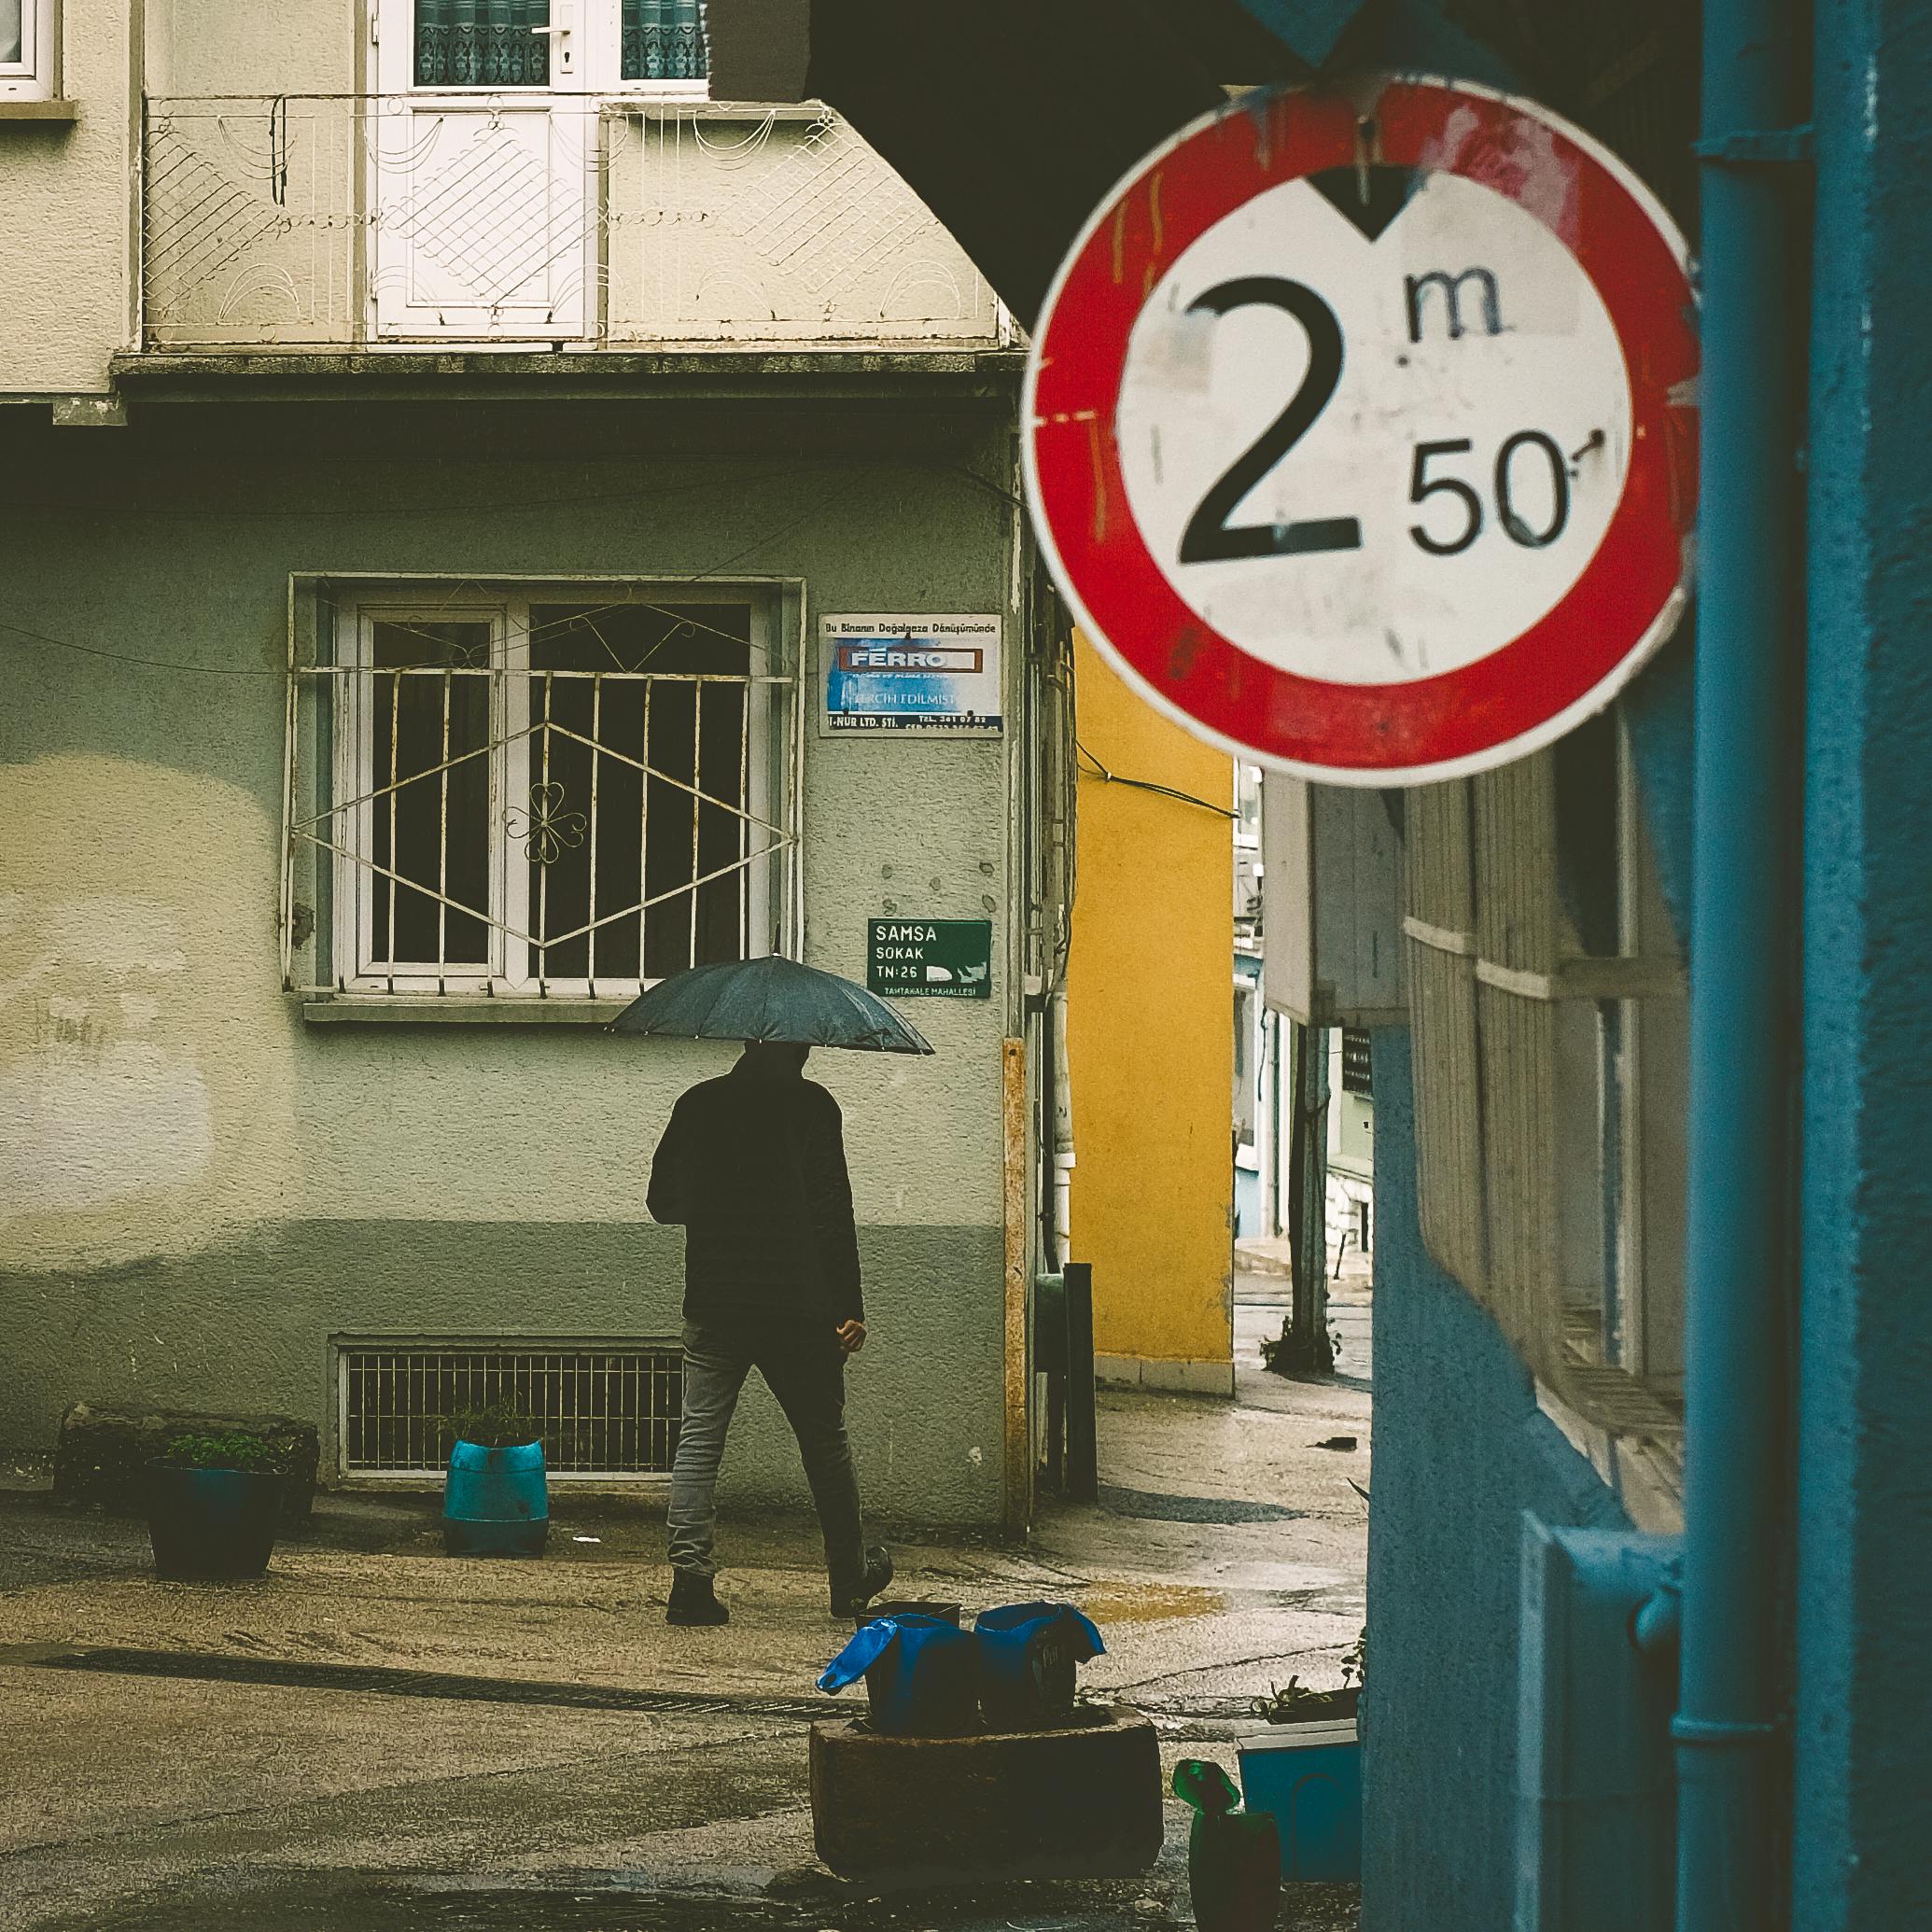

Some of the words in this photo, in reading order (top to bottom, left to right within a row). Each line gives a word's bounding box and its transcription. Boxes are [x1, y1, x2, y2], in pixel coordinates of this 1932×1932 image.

[1405, 266, 1502, 343] m
[1179, 274, 1363, 566] 2
[1409, 429, 1572, 555] 50
[825, 623, 837, 633] Bu
[860, 717, 880, 728] LTD.
[875, 926, 937, 942] SAMSA
[875, 946, 924, 959] SOKAK
[875, 965, 917, 978] TN:26
[884, 987, 929, 996] TAHTAKALE
[931, 987, 976, 996] MAHALLESİ
